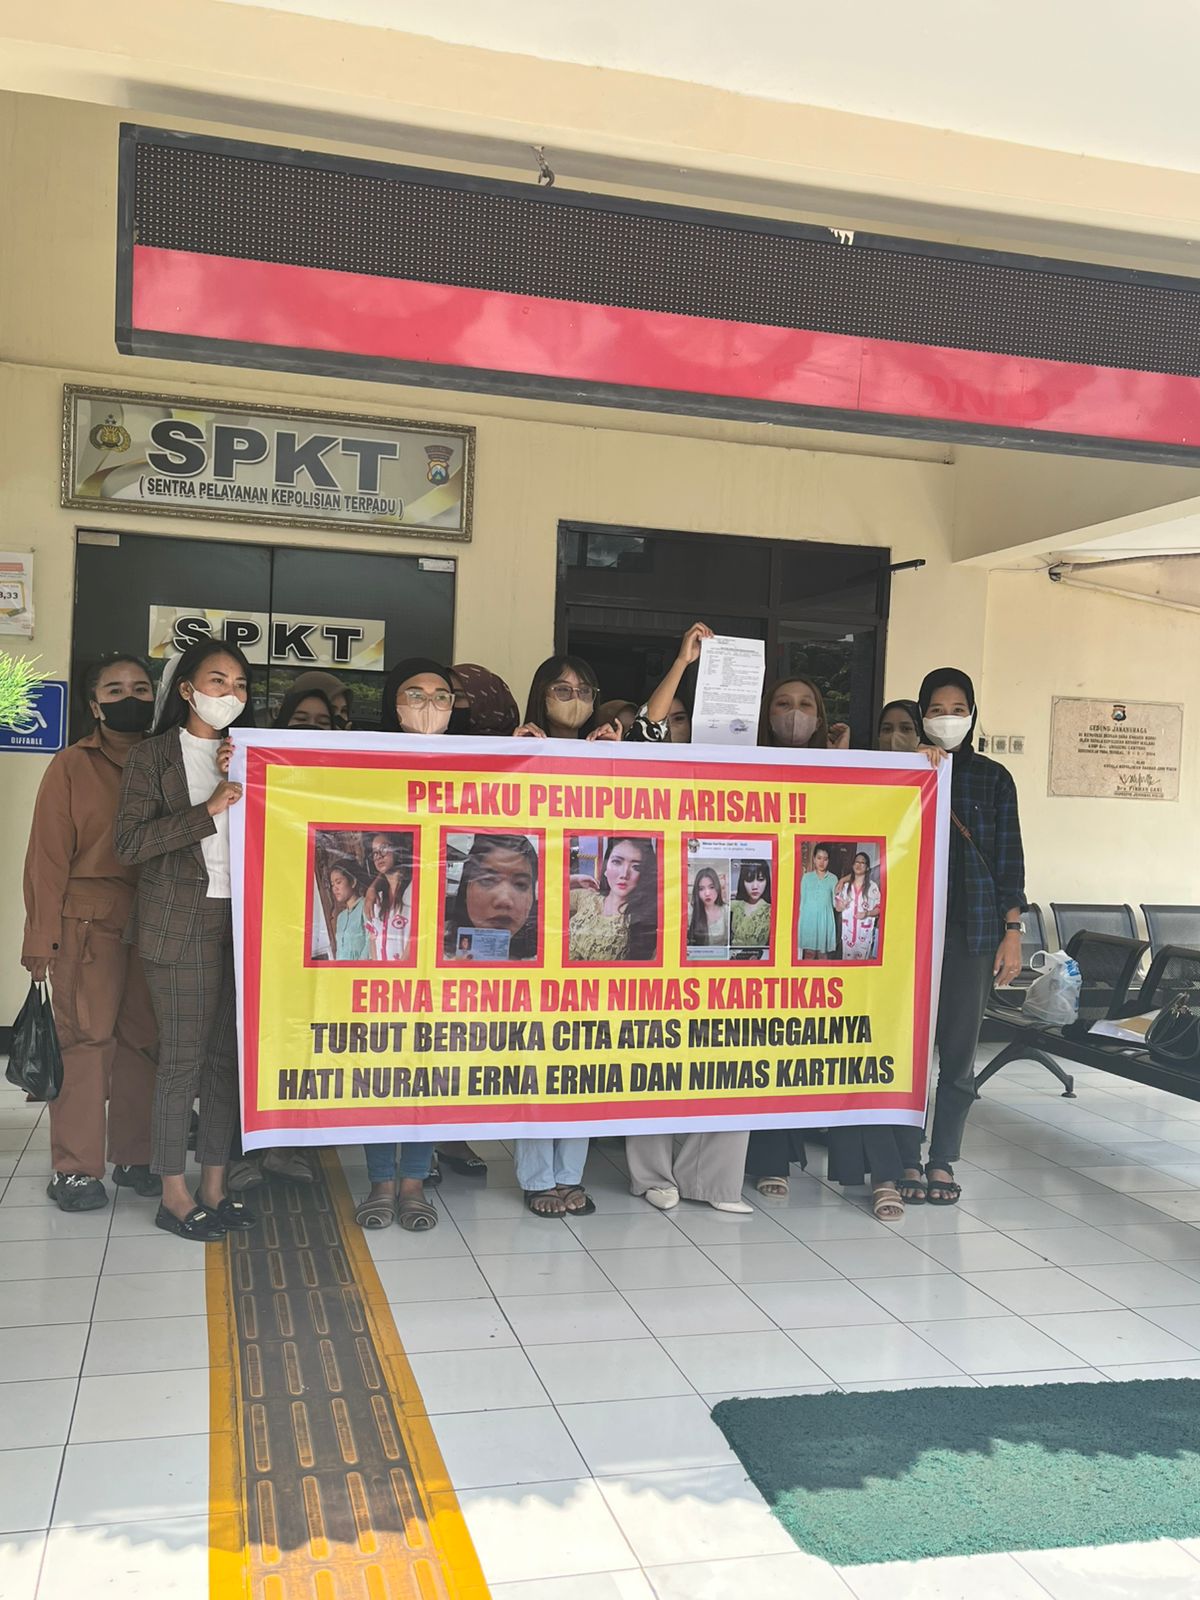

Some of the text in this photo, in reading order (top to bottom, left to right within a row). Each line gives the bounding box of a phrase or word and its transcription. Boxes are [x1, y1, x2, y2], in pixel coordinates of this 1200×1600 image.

[146, 418, 399, 494] SPKT
[199, 483, 268, 502] PELAYANAN
[271, 489, 341, 510] KEPOLISIAN
[173, 616, 363, 662] SPKT
[11, 737, 43, 745] DIFFABLE
[407, 780, 520, 816] PELAKU
[529, 784, 671, 820] PENIPUAN
[678, 789, 781, 823] ARISAN
[352, 977, 844, 1013] ERNA ERNIA DAN NIMAS KARTIKAS
[310, 1015, 872, 1053] TURUT BERDUKA CITA ATAS MENINGGALNYA
[278, 1055, 894, 1100] HATI NURANI ERNA ERNIA DAN NIMAS KARTIKAS
